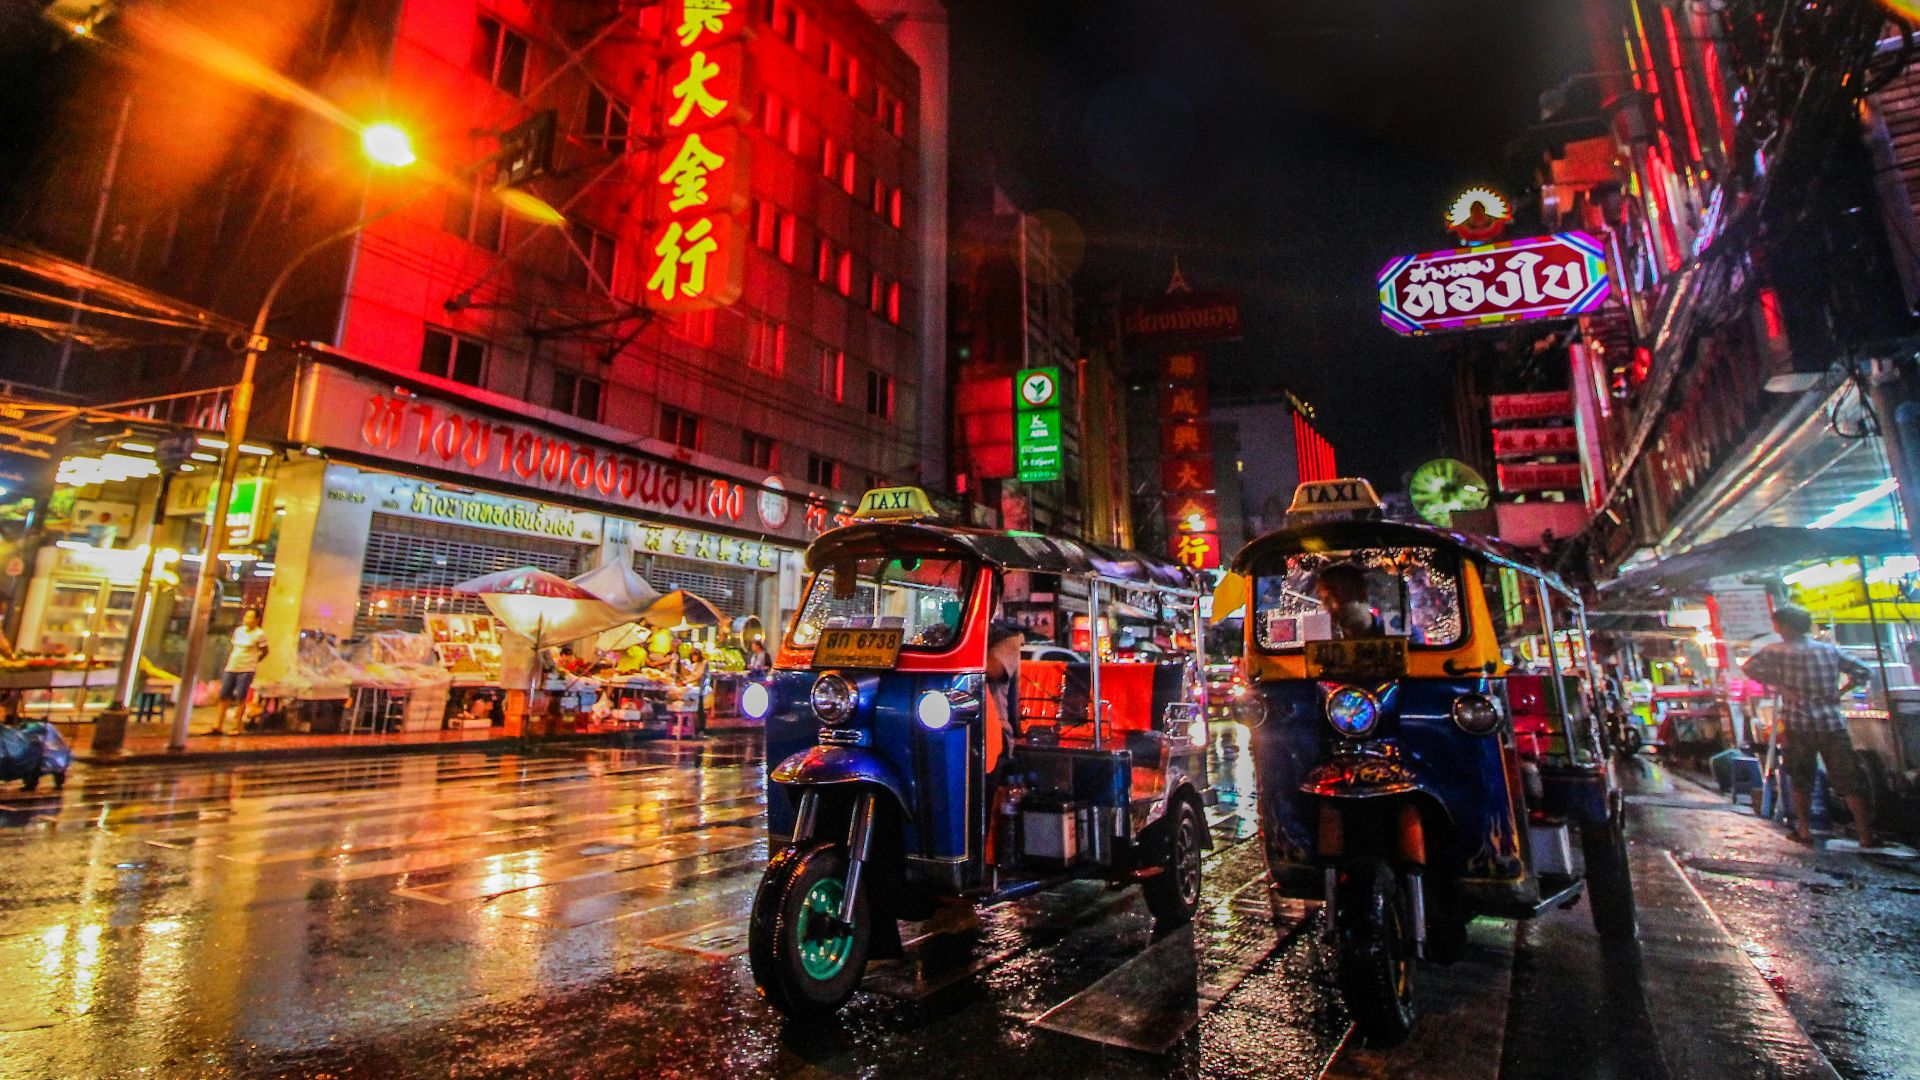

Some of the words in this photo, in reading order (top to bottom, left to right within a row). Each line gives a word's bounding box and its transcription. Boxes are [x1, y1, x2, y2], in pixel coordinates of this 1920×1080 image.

[1402, 251, 1584, 317] ทองใบ
[869, 491, 910, 510] TAXI
[1303, 483, 1359, 503] TAXI
[857, 633, 897, 650] 6738
